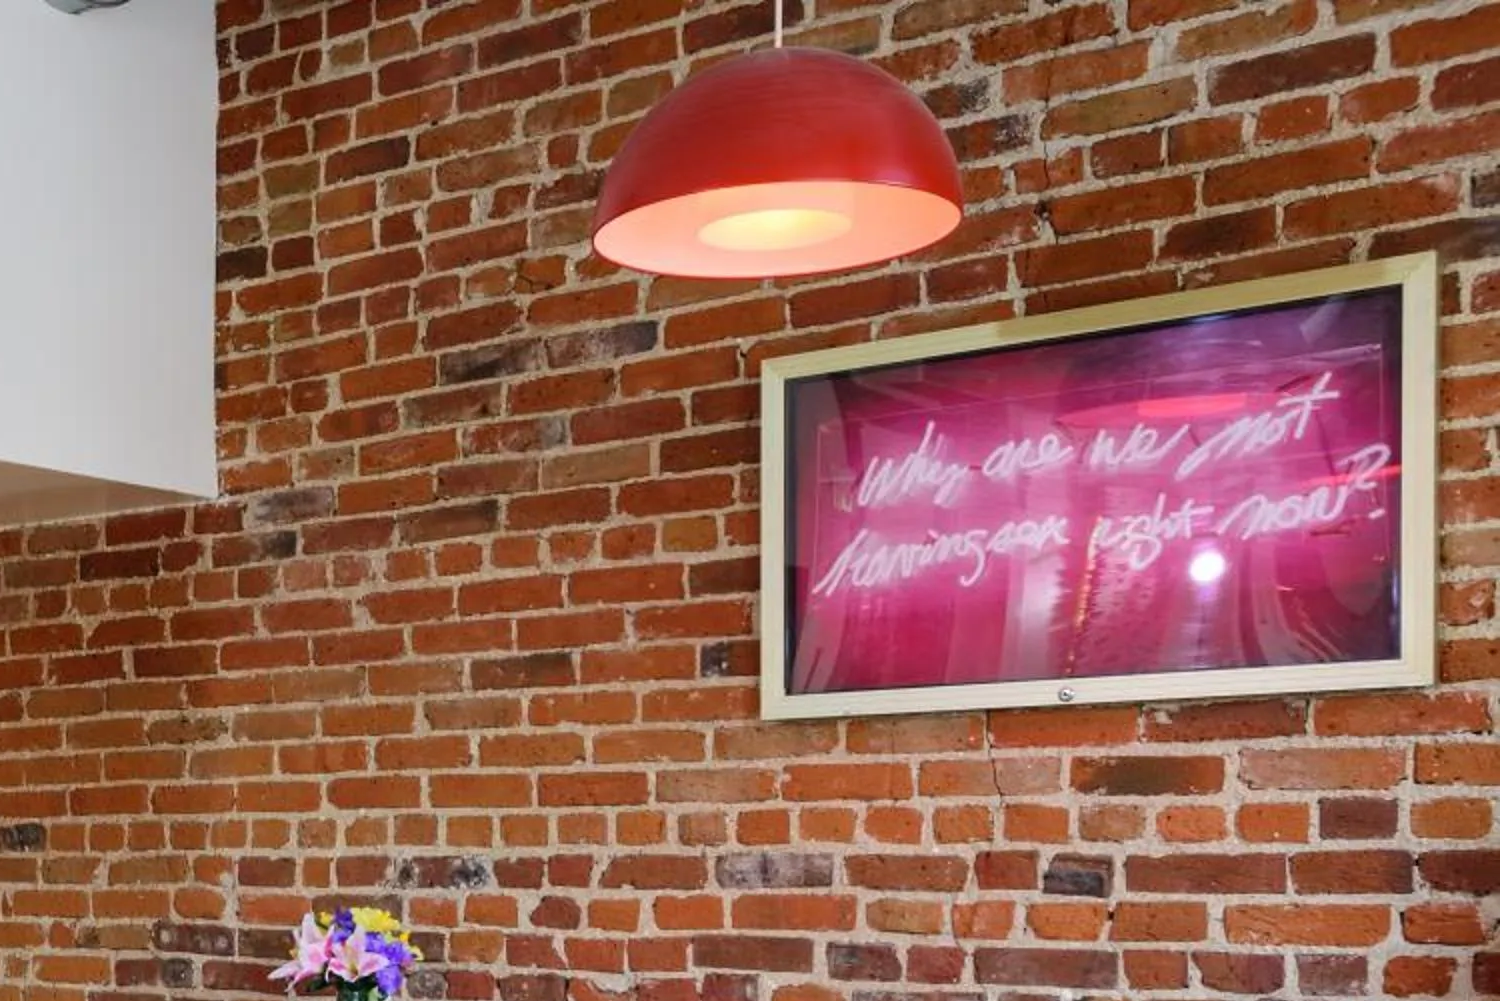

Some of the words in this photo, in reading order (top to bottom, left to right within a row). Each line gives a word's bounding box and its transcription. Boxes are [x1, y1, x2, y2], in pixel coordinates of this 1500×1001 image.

[981, 432, 1075, 478] are
[1090, 422, 1190, 468] we
[811, 527, 989, 598] having
[986, 514, 1071, 553] sex
[1087, 491, 1215, 572] right
